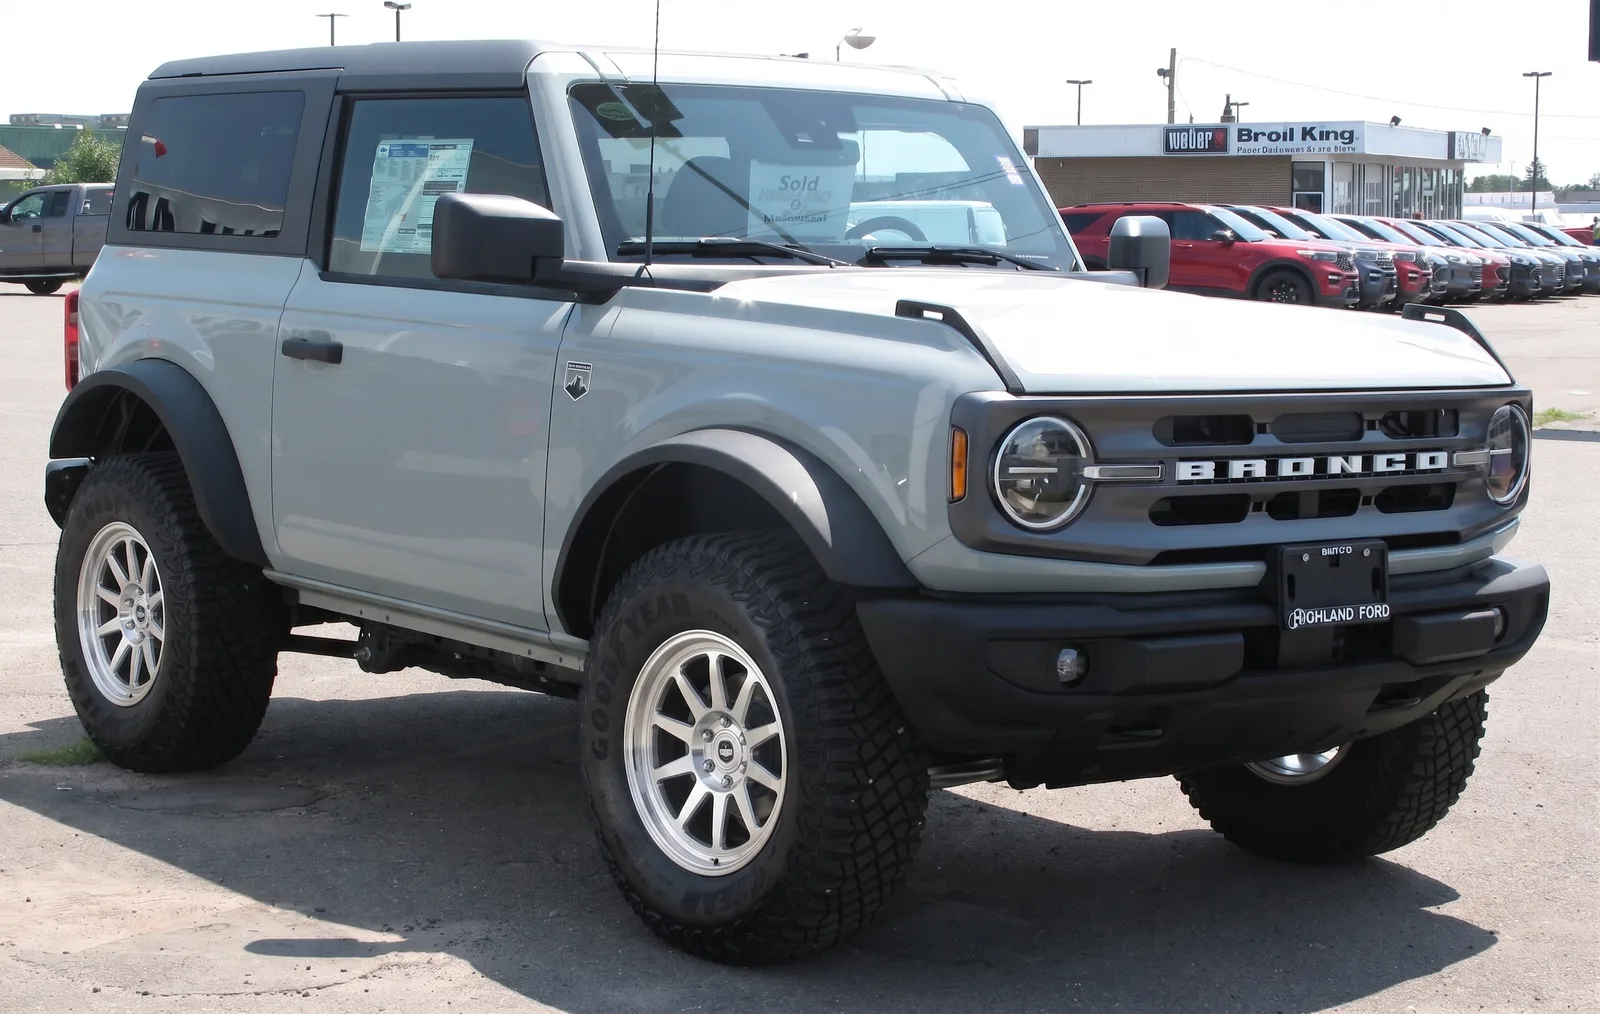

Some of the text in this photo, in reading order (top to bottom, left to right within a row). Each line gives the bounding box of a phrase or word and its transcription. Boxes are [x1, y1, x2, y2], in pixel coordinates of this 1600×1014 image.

[1169, 128, 1213, 150] weber
[1237, 126, 1355, 145] Broil King
[779, 175, 820, 191] Sold
[1175, 451, 1448, 480] BRONCO
[1288, 604, 1390, 630] HGHLAND FORD
